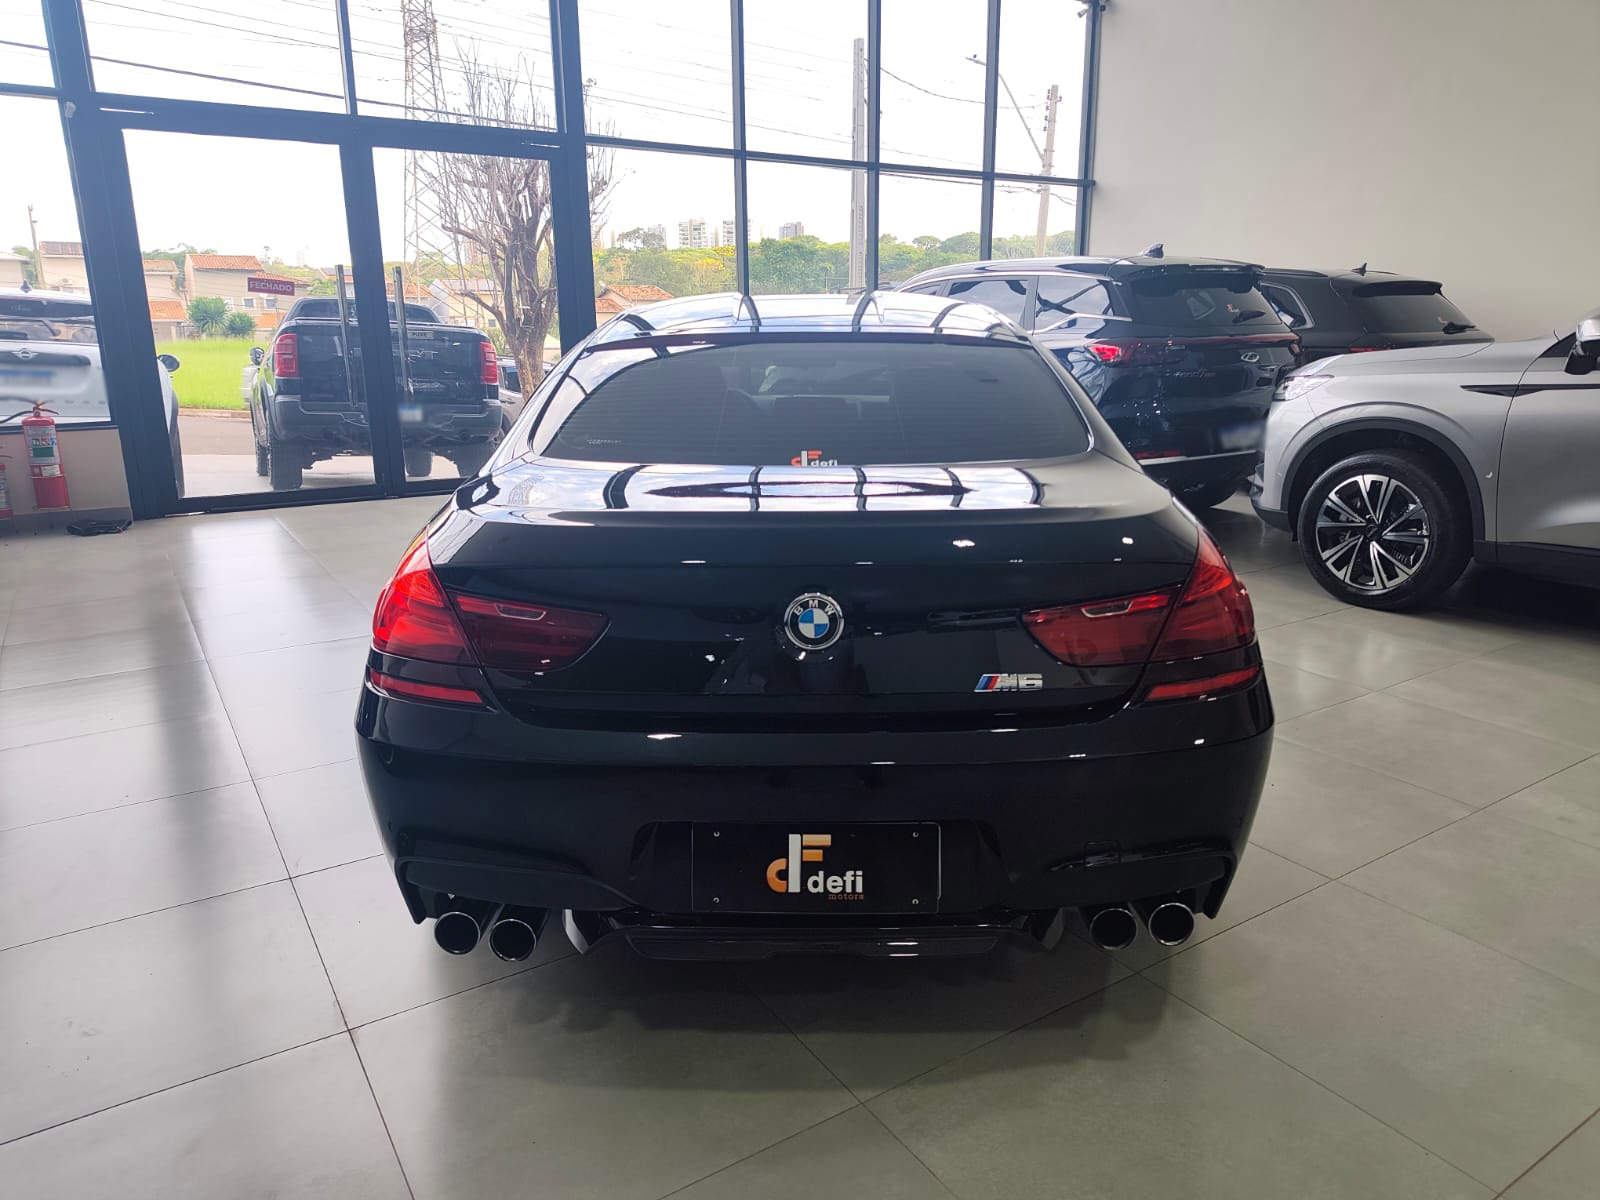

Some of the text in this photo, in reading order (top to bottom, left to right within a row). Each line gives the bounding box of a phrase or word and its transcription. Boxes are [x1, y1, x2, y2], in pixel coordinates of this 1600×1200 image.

[249, 281, 293, 292] FECHADO
[793, 599, 836, 616] BMW
[989, 673, 1043, 692] M6
[807, 870, 863, 894] defi
